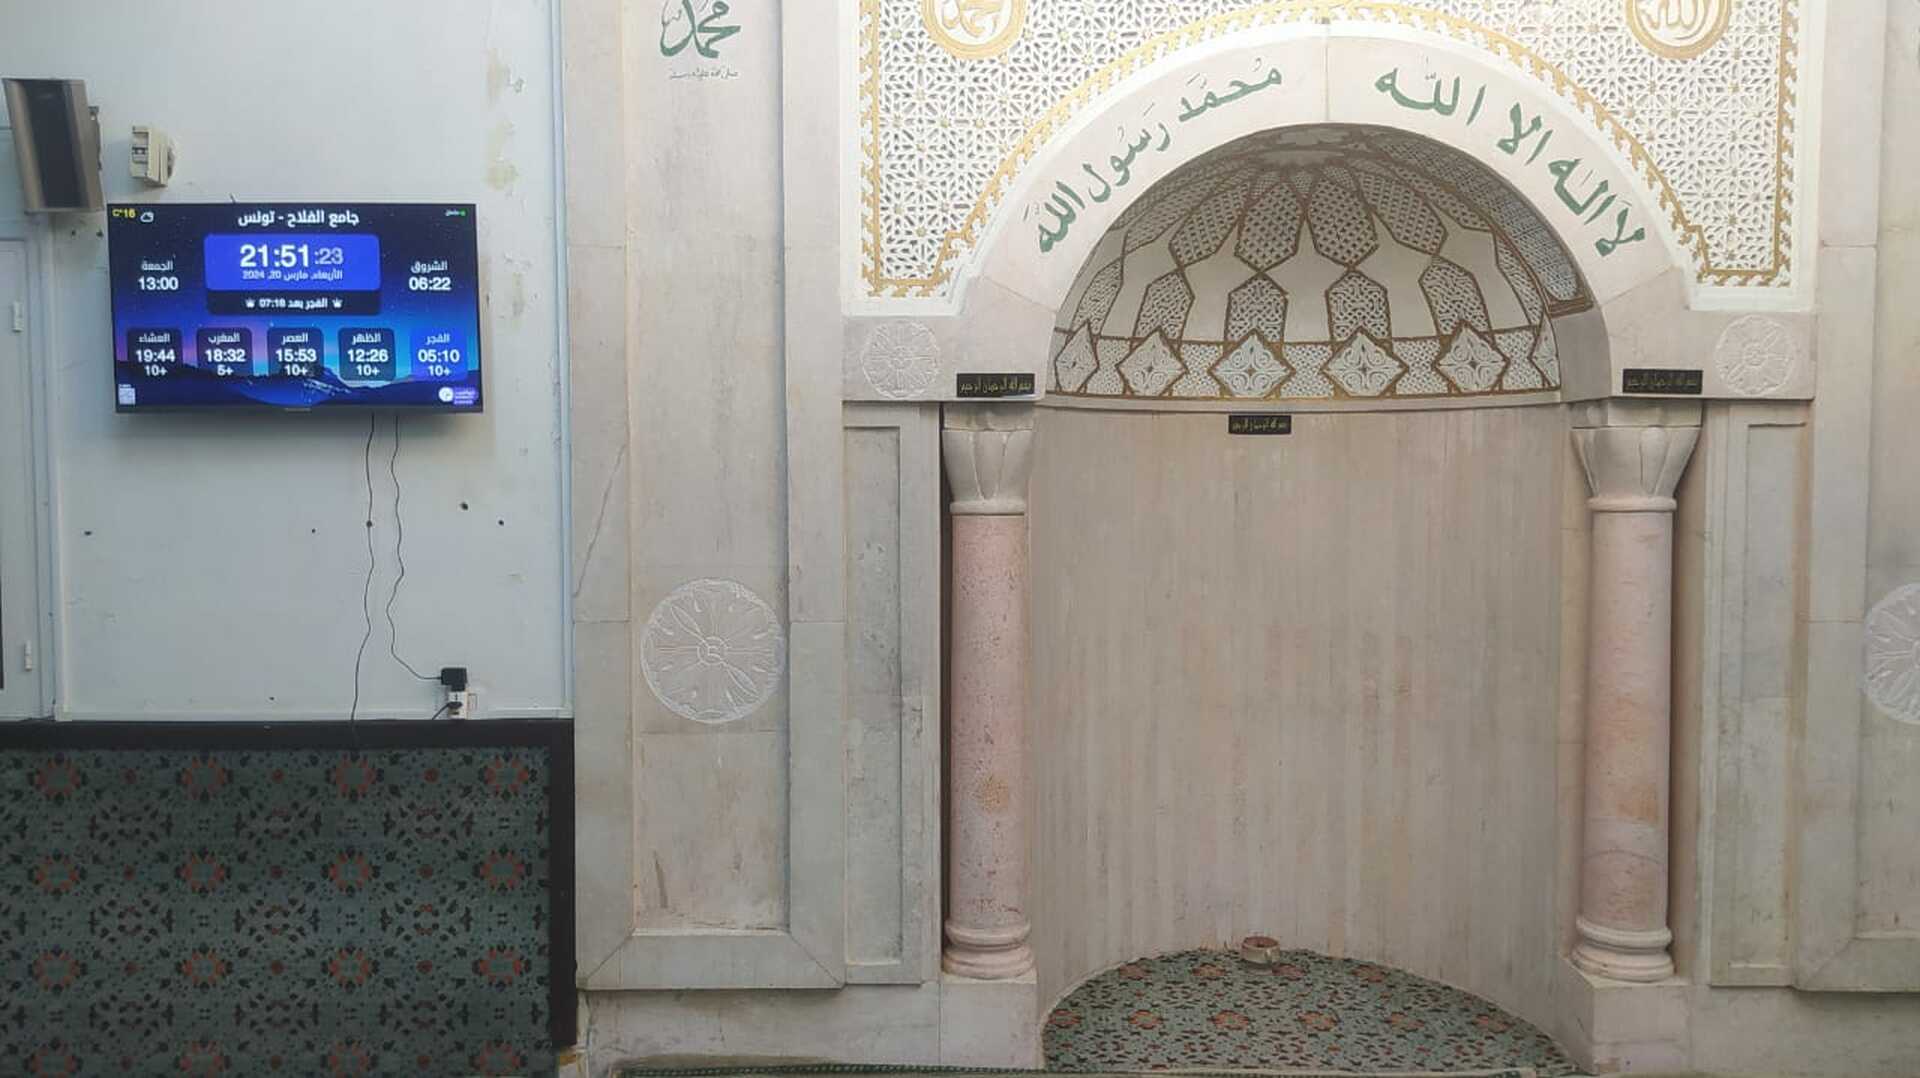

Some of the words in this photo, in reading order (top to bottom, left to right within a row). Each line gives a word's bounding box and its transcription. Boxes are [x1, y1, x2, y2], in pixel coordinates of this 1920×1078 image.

[238, 210, 275, 227] تونس
[287, 209, 324, 227] الفلاح
[329, 209, 359, 227] جامع
[141, 259, 173, 271] الجمعة
[411, 260, 447, 273] الشروق
[138, 277, 179, 290] 13:00
[409, 277, 451, 291] 06:22
[139, 333, 170, 343] العشاء
[208, 332, 240, 344] المغرب
[282, 333, 308, 345] العصر
[352, 332, 381, 345] الظهر
[426, 333, 450, 346] الفجر
[136, 349, 176, 362] 19:44
[205, 349, 246, 362] 18:32
[276, 348, 317, 362] 15:53
[348, 349, 389, 362] 12:26
[418, 349, 460, 362] 05:10
